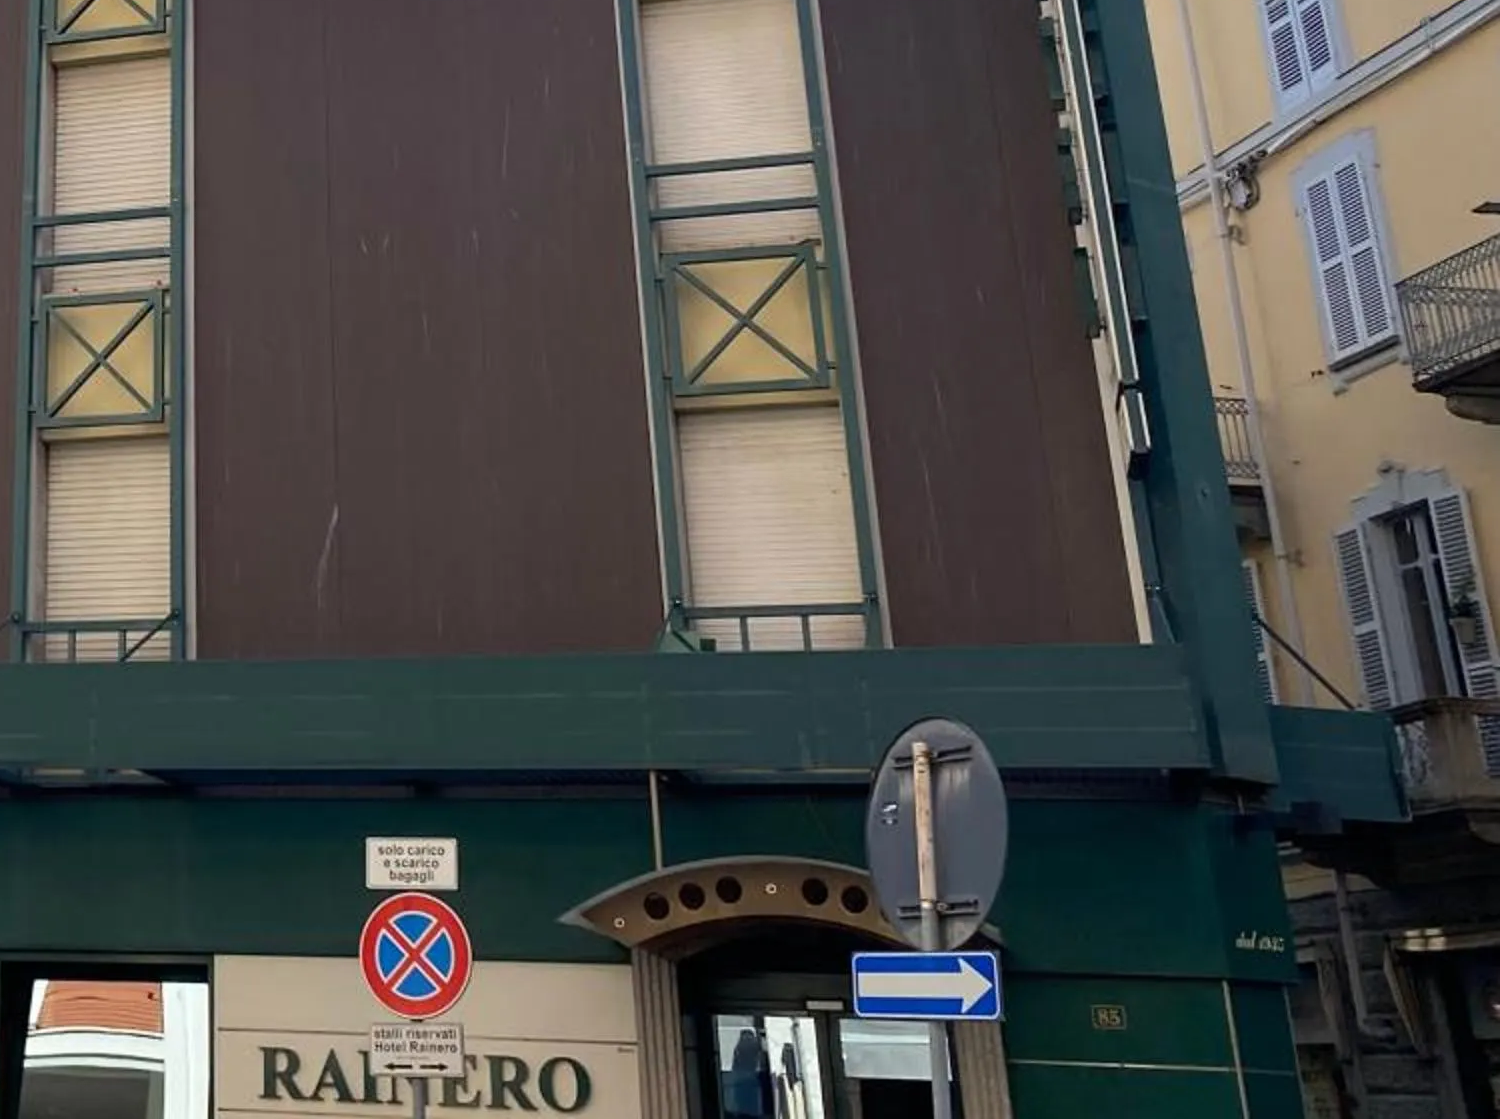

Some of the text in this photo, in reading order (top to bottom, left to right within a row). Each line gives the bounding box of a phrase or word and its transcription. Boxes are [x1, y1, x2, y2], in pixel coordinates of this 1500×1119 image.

[378, 843, 445, 856] solo carico
[383, 858, 439, 869] e scarico
[389, 869, 434, 883] bagagli
[374, 1028, 457, 1040] stalli riservati
[374, 1041, 458, 1053] Hotel Rainero
[258, 1046, 593, 1114] RAIERO
